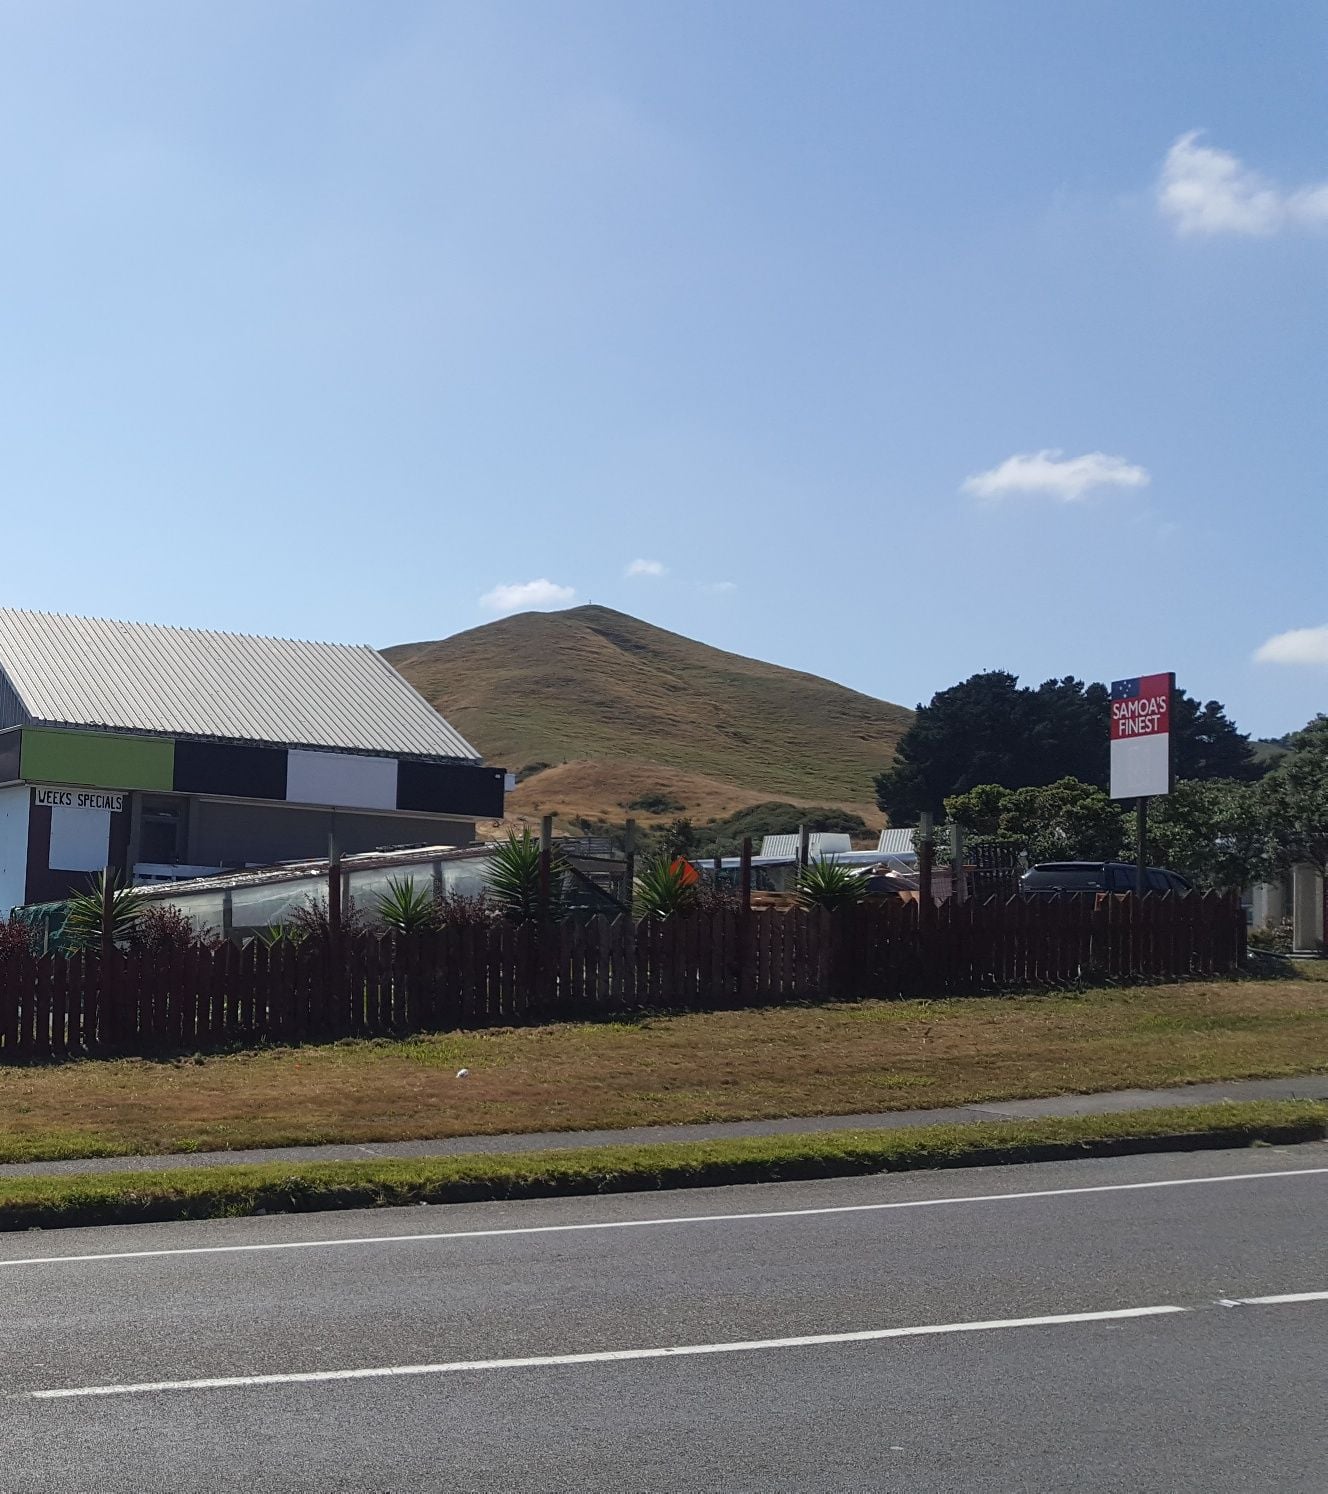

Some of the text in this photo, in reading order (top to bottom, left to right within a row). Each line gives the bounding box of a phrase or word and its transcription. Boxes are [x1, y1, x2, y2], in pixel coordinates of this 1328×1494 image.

[1112, 695, 1166, 720] SAMOA'S
[1118, 714, 1161, 736] FINEST
[38, 789, 122, 810] WEEKS SPECIALS
